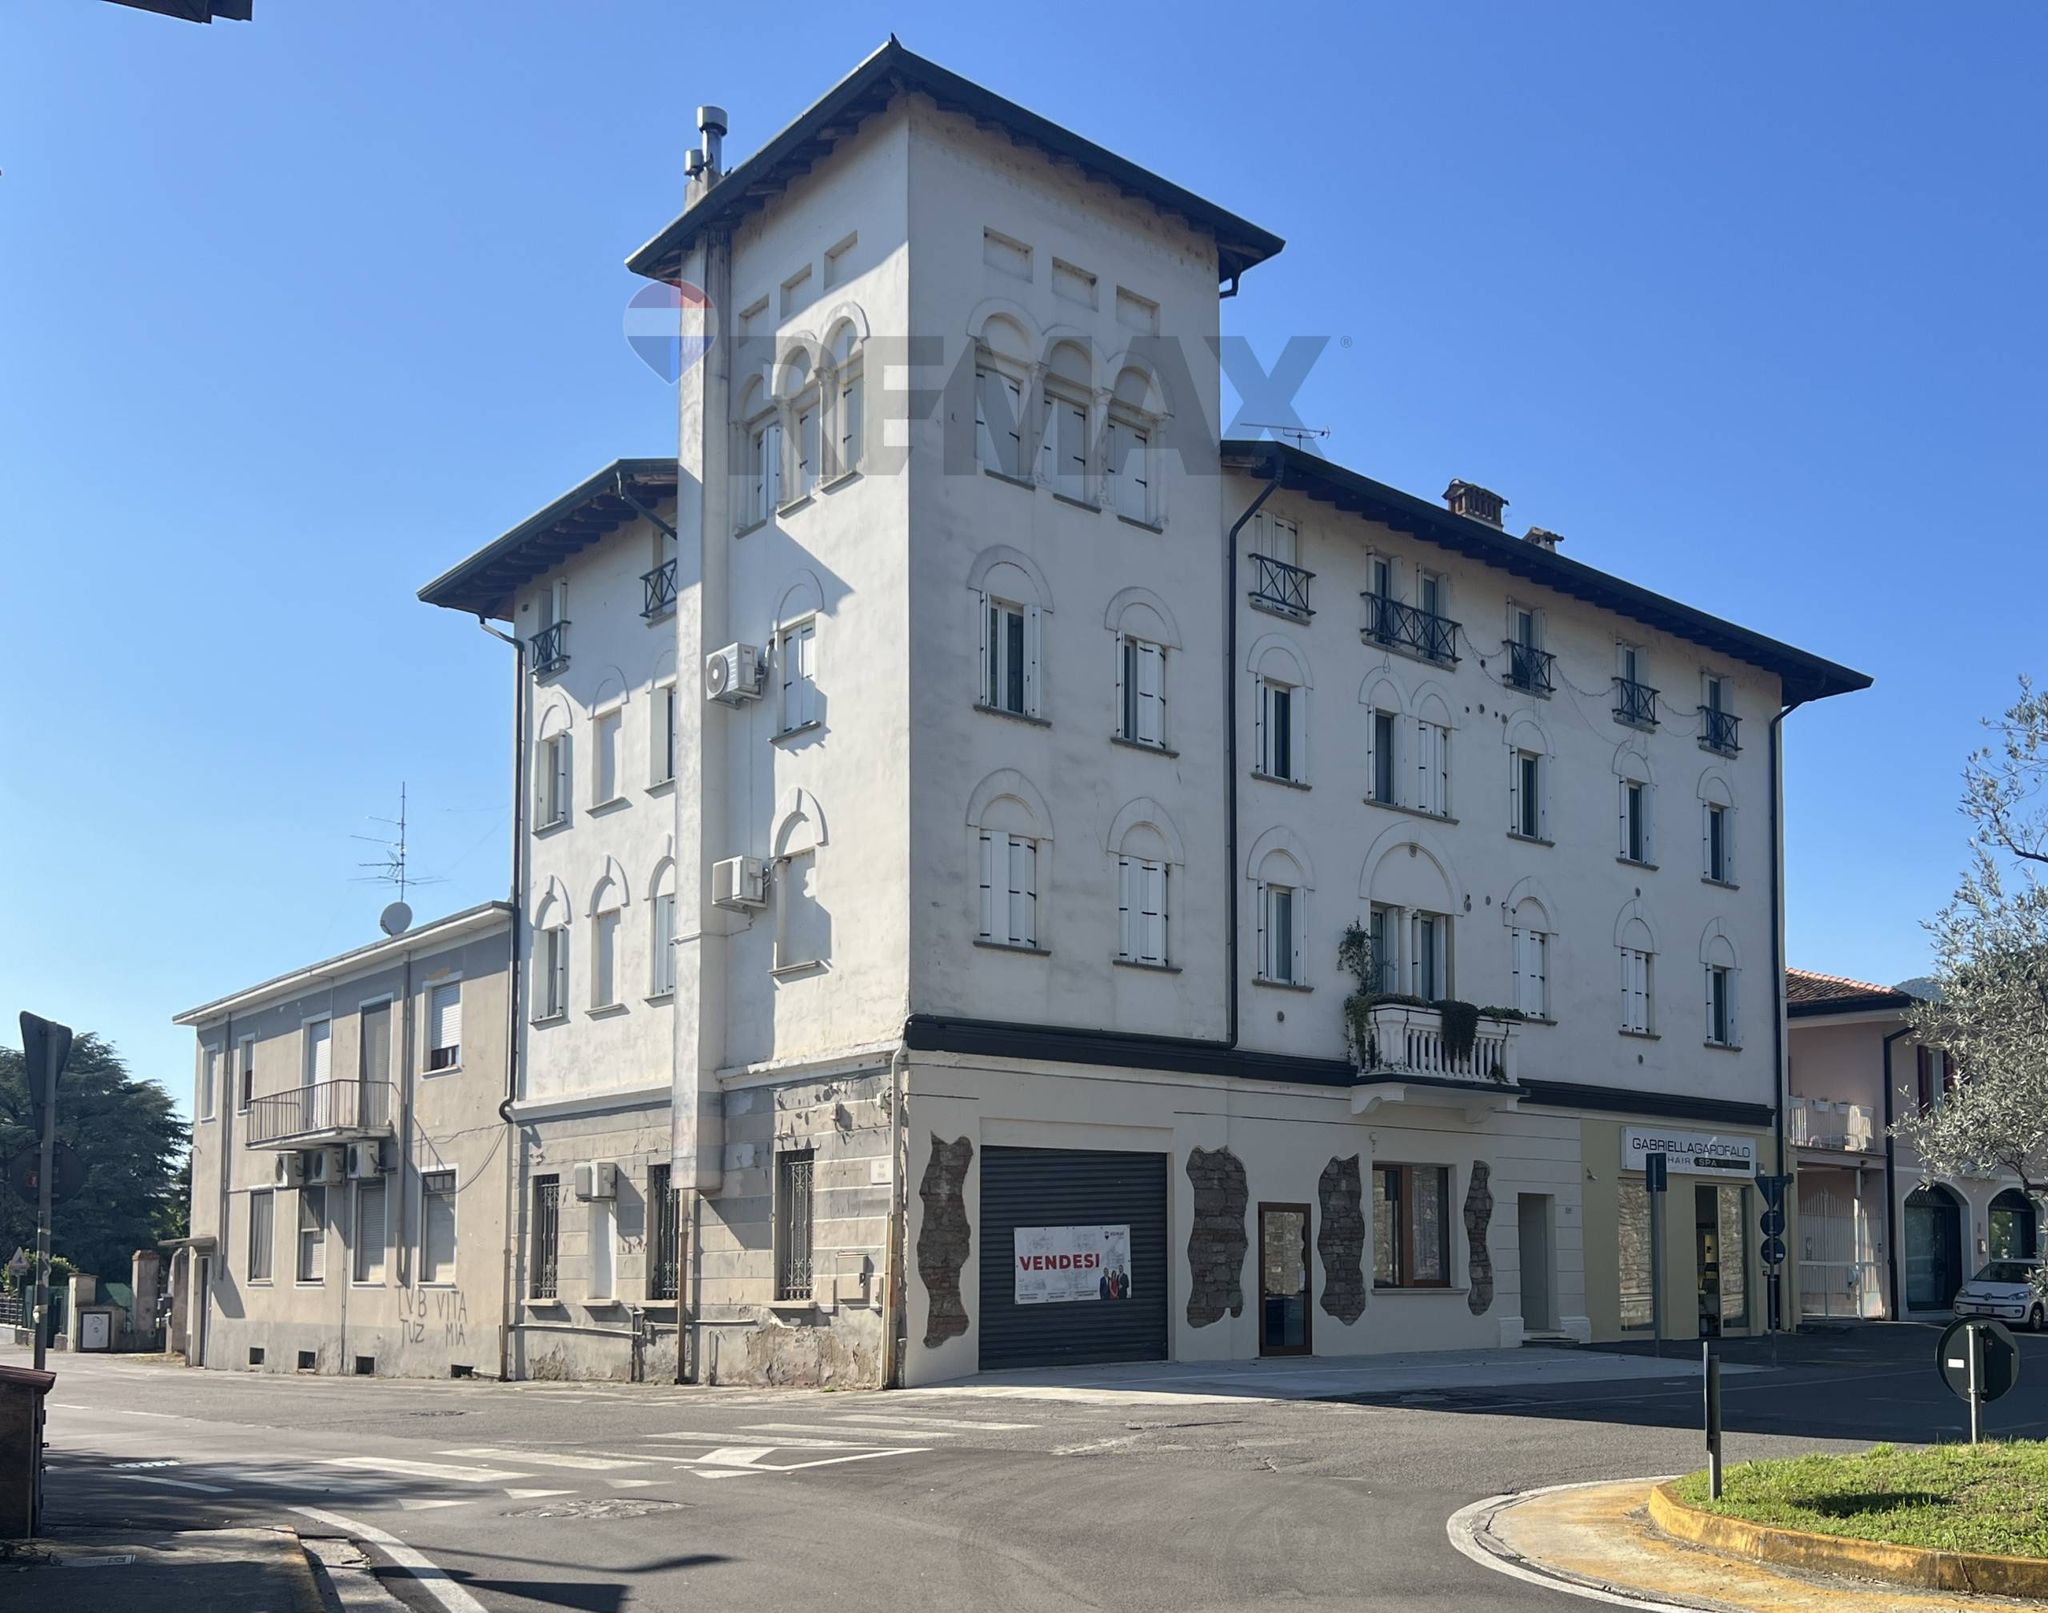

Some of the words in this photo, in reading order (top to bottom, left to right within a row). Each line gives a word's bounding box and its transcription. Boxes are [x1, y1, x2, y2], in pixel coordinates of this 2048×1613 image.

[1667, 1156, 1691, 1165] HAIR
[1699, 1158, 1718, 1167] SPA
[1019, 1253, 1100, 1271] VENDESI
[436, 1290, 468, 1324] VITA
